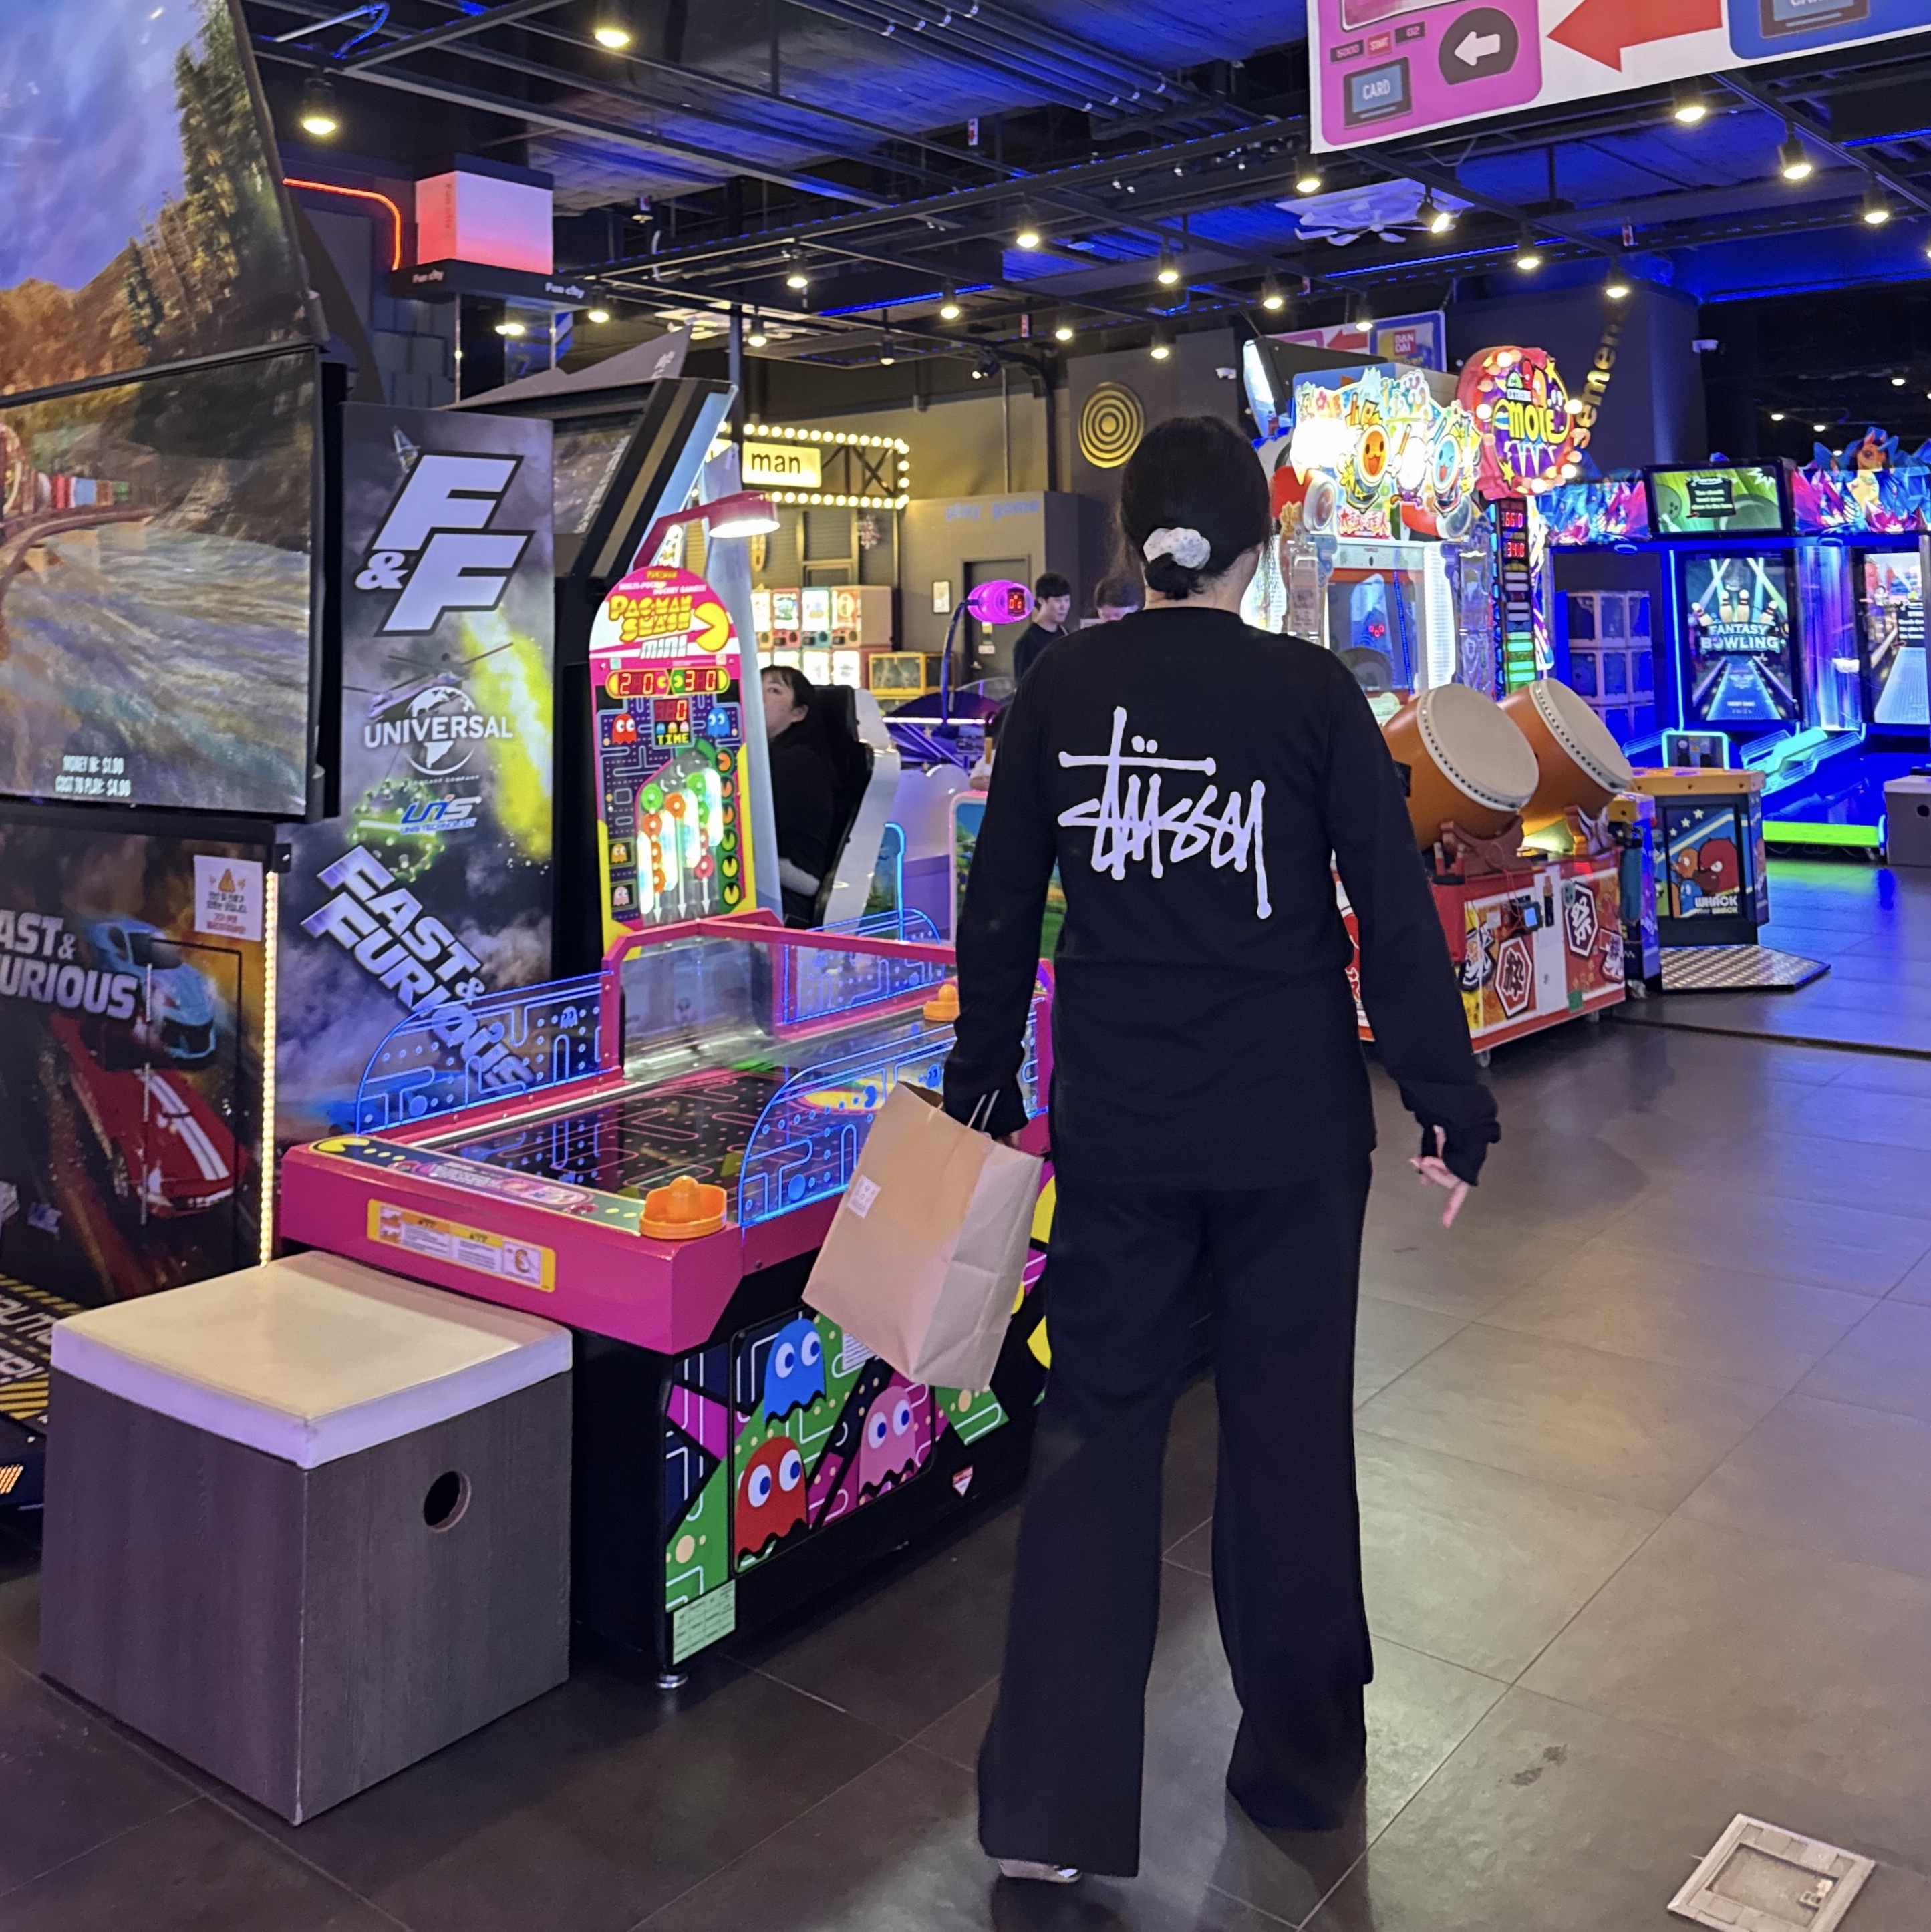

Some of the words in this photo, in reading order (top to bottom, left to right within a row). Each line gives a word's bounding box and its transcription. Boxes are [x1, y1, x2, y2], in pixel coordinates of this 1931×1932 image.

[1362, 79, 1391, 100] CARD
[750, 452, 801, 475] man
[355, 552, 409, 590] &
[619, 612, 692, 643] SMASH
[1709, 623, 1769, 635] FANTASY
[640, 635, 688, 659] mini
[1700, 635, 1779, 650] BOWLING
[364, 716, 514, 749] UNIVERSAL
[656, 732, 690, 746] TIME
[1694, 896, 1738, 907] WHACK
[317, 845, 482, 982] FAST
[455, 977, 485, 1005] &
[57, 933, 76, 960] &
[300, 891, 535, 1092] FURIOUS
